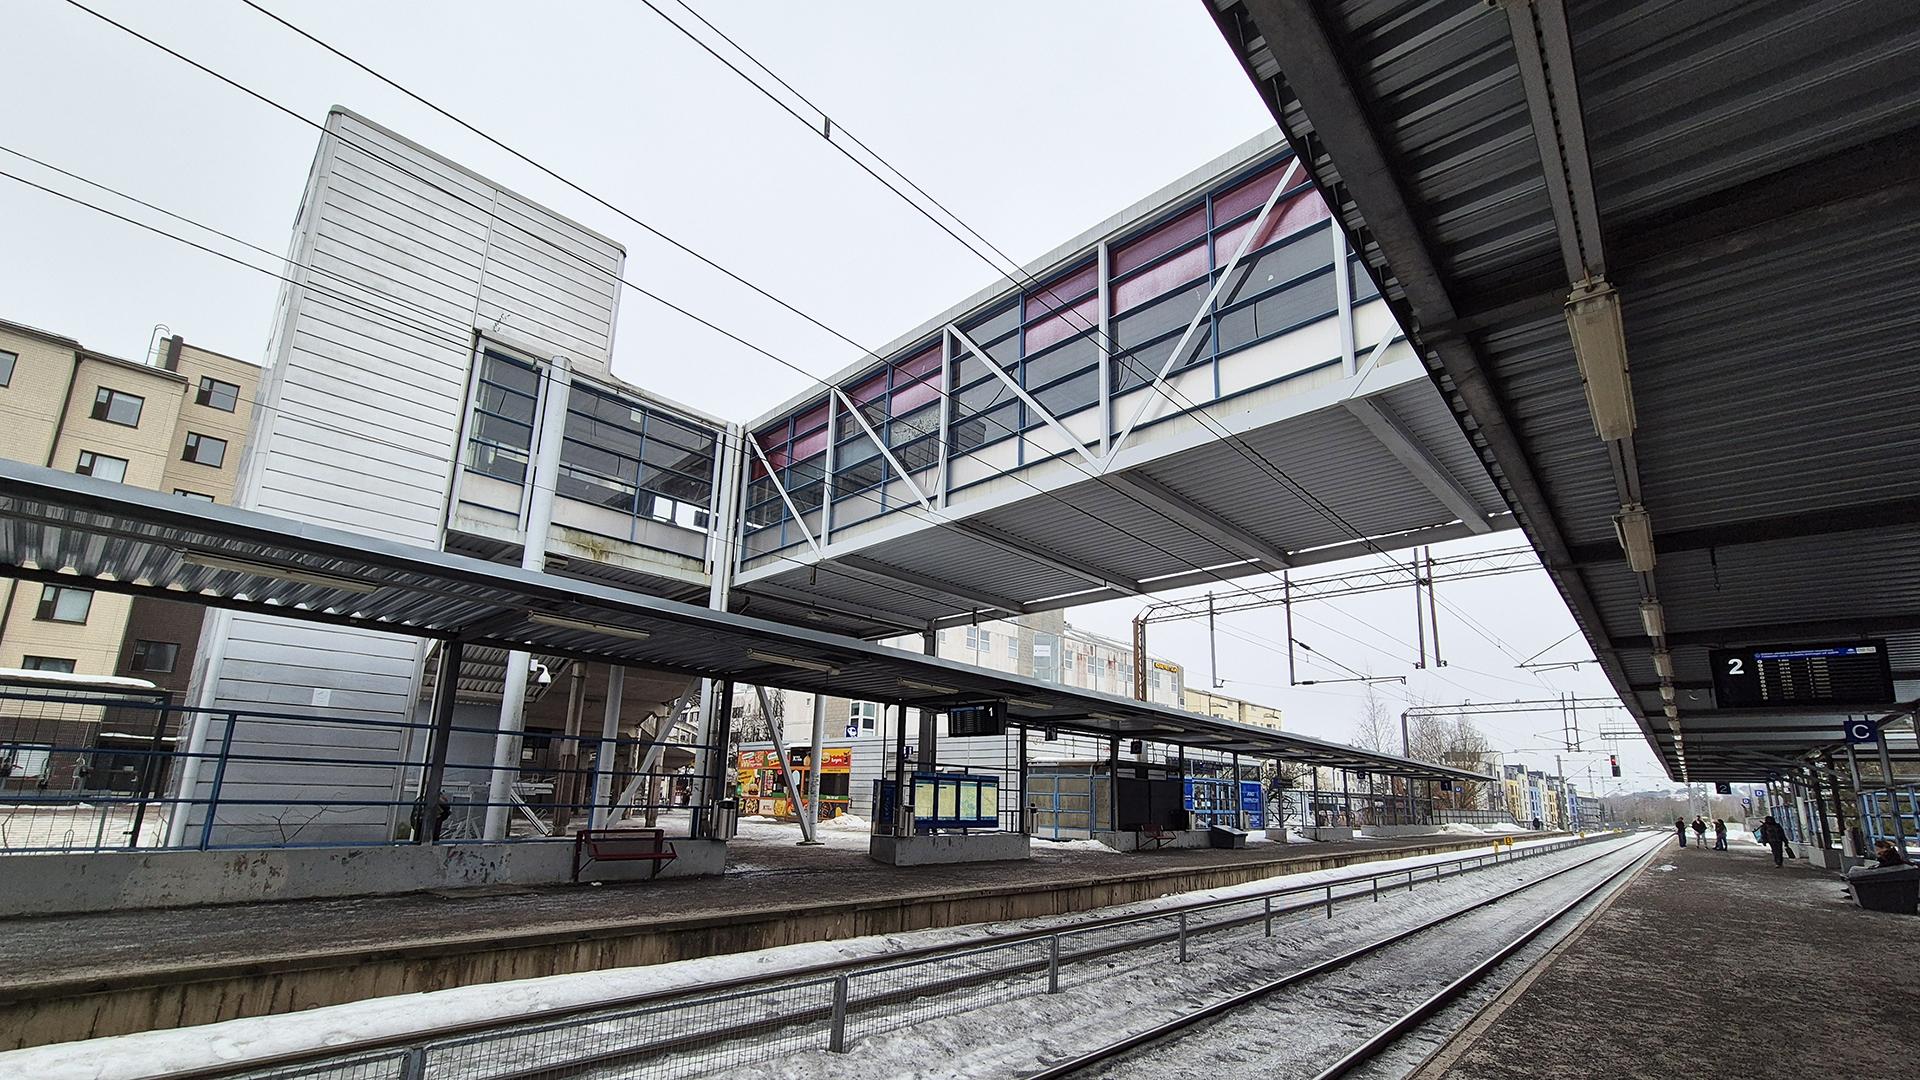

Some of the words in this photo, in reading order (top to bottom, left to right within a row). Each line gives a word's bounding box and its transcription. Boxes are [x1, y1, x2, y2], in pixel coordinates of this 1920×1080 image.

[1728, 658, 1744, 675] 2
[988, 706, 993, 717] 1
[1852, 724, 1870, 739] C
